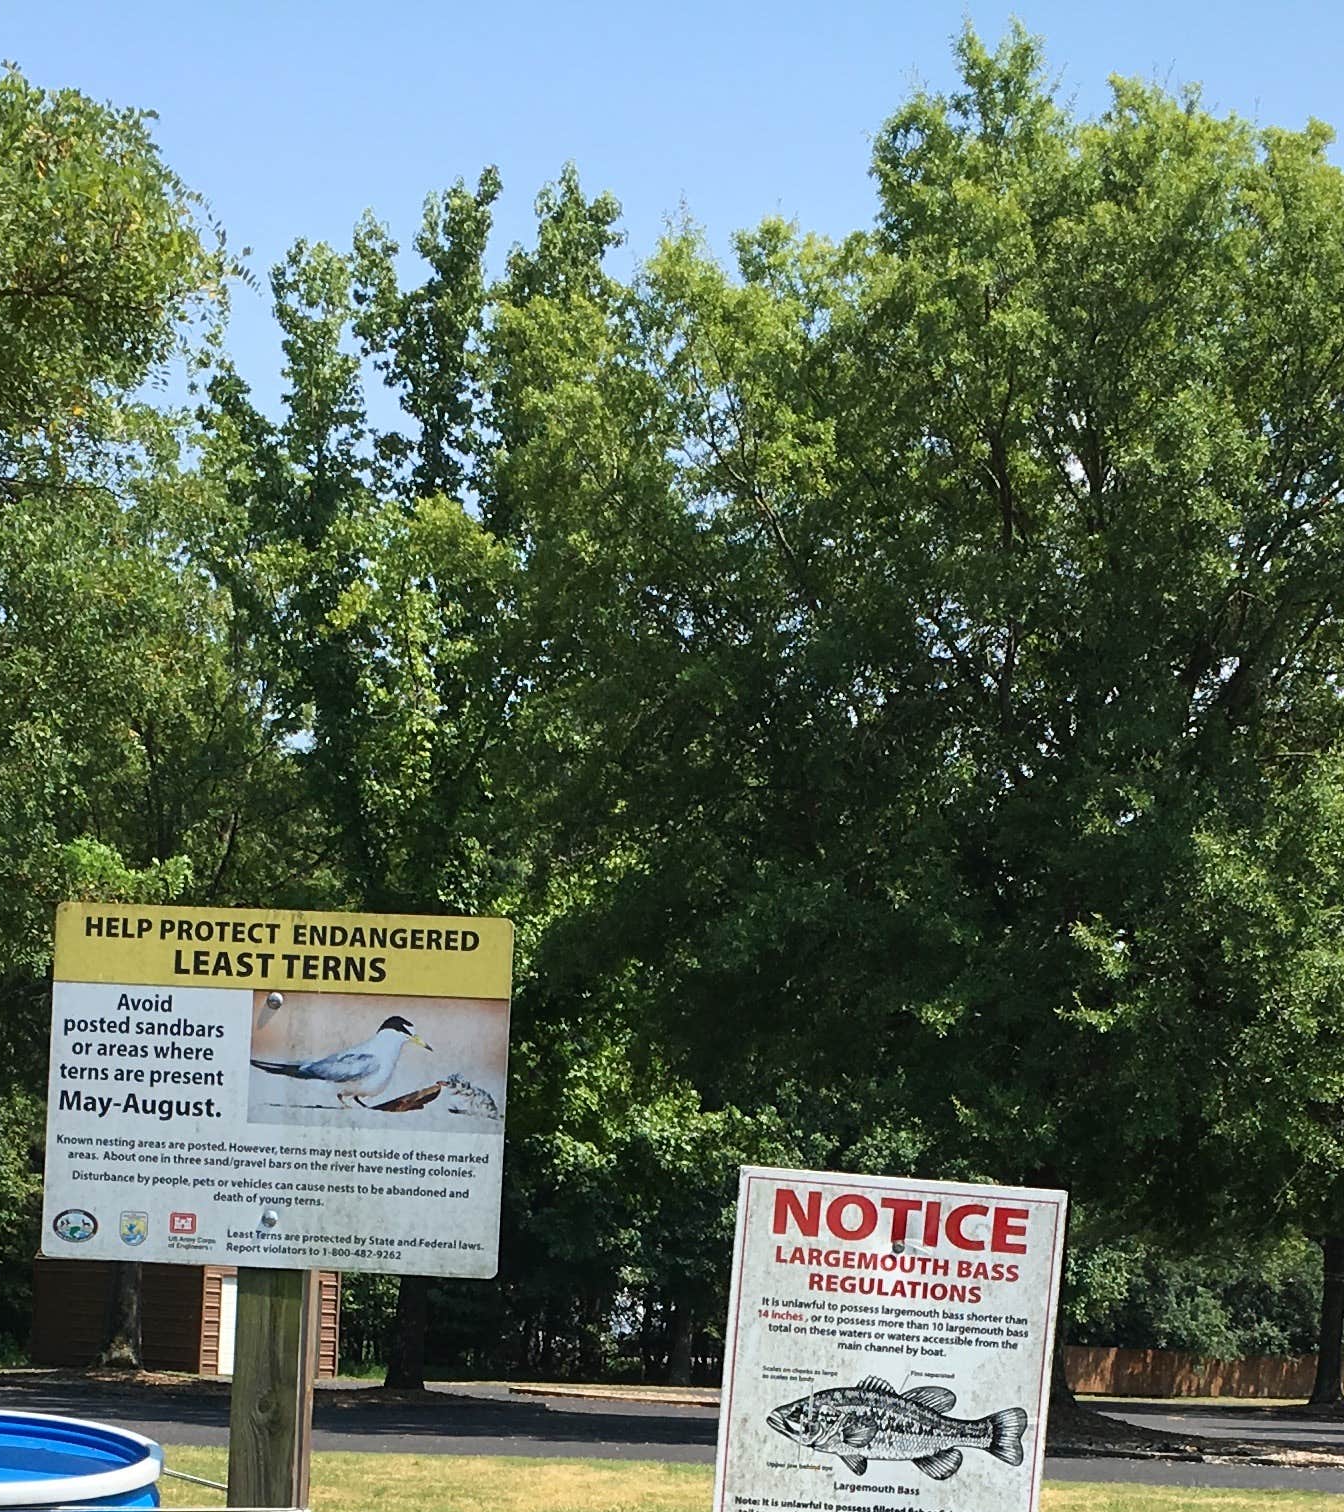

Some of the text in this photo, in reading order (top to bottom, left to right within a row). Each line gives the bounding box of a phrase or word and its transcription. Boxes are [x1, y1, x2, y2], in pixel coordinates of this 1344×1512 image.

[85, 916, 479, 951] HELP PROTECT ENDANGERED
[174, 950, 386, 982] LEAST TERNS
[117, 993, 172, 1012] Avoid
[63, 1016, 224, 1038] posted sandbars
[71, 1041, 213, 1060] or areas where
[60, 1063, 224, 1088] terns are present
[59, 1090, 220, 1120] May-August.
[56, 1134, 93, 1145] Known
[95, 1137, 135, 1150] nesting
[137, 1140, 166, 1149] areas
[168, 1141, 186, 1150] are
[279, 1145, 307, 1155] terns
[309, 1148, 332, 1158] may
[334, 1148, 357, 1158] nest
[359, 1149, 400, 1160] outside
[401, 1149, 414, 1160] of
[415, 1151, 445, 1162] these
[447, 1153, 489, 1164] marked
[102, 1151, 136, 1162] About
[137, 1154, 158, 1163] one
[160, 1153, 171, 1164] in
[173, 1154, 202, 1165] three
[204, 1156, 266, 1169] sand/gravel
[268, 1158, 292, 1170] bars
[293, 1162, 308, 1170] on
[310, 1160, 328, 1171] the
[330, 1161, 355, 1172] river
[357, 1162, 383, 1174] have
[385, 1164, 426, 1177] nesting
[72, 1170, 134, 1182] Disturbance
[136, 1173, 150, 1186] by
[192, 1178, 215, 1188] pets
[217, 1179, 229, 1187] or
[231, 1178, 272, 1189] vehicles
[274, 1182, 293, 1190] can
[295, 1183, 325, 1192] cause
[327, 1184, 354, 1193] nests
[357, 1184, 369, 1194] to
[370, 1183, 384, 1195] be
[386, 1185, 447, 1198] abandoned
[448, 1188, 469, 1199] and
[213, 1192, 244, 1202] death
[245, 1193, 258, 1203] of
[259, 1196, 292, 1207] young
[772, 1188, 1029, 1254] NOTICE
[226, 1229, 253, 1239] Least
[255, 1230, 282, 1240] Terns
[284, 1233, 300, 1242] are
[302, 1234, 352, 1244] protected
[353, 1234, 367, 1246] by
[368, 1235, 395, 1246] State
[397, 1237, 417, 1247] and
[418, 1238, 457, 1249] Federal
[226, 1243, 260, 1254] Report
[263, 1245, 307, 1255] violators
[308, 1247, 320, 1256] to
[775, 1245, 1019, 1281] LARGEMOUTH BASS
[808, 1273, 982, 1303] REGULATIONS
[757, 1309, 769, 1318] 14
[810, 1314, 822, 1323] or
[824, 1314, 835, 1324] to
[836, 1316, 875, 1326] possess
[877, 1319, 904, 1328] more
[906, 1319, 929, 1330] than
[932, 1322, 944, 1332] 10
[945, 1322, 1004, 1336] largemouth
[1006, 1326, 1028, 1338] bass
[761, 1296, 1028, 1325] It is unlawful to possess largemouth bass shorter than
[768, 1323, 1018, 1350] total on these waters or waters accessible from the
[837, 1341, 946, 1357] main channel by boat.
[833, 1481, 920, 1496] Largemouth Bass
